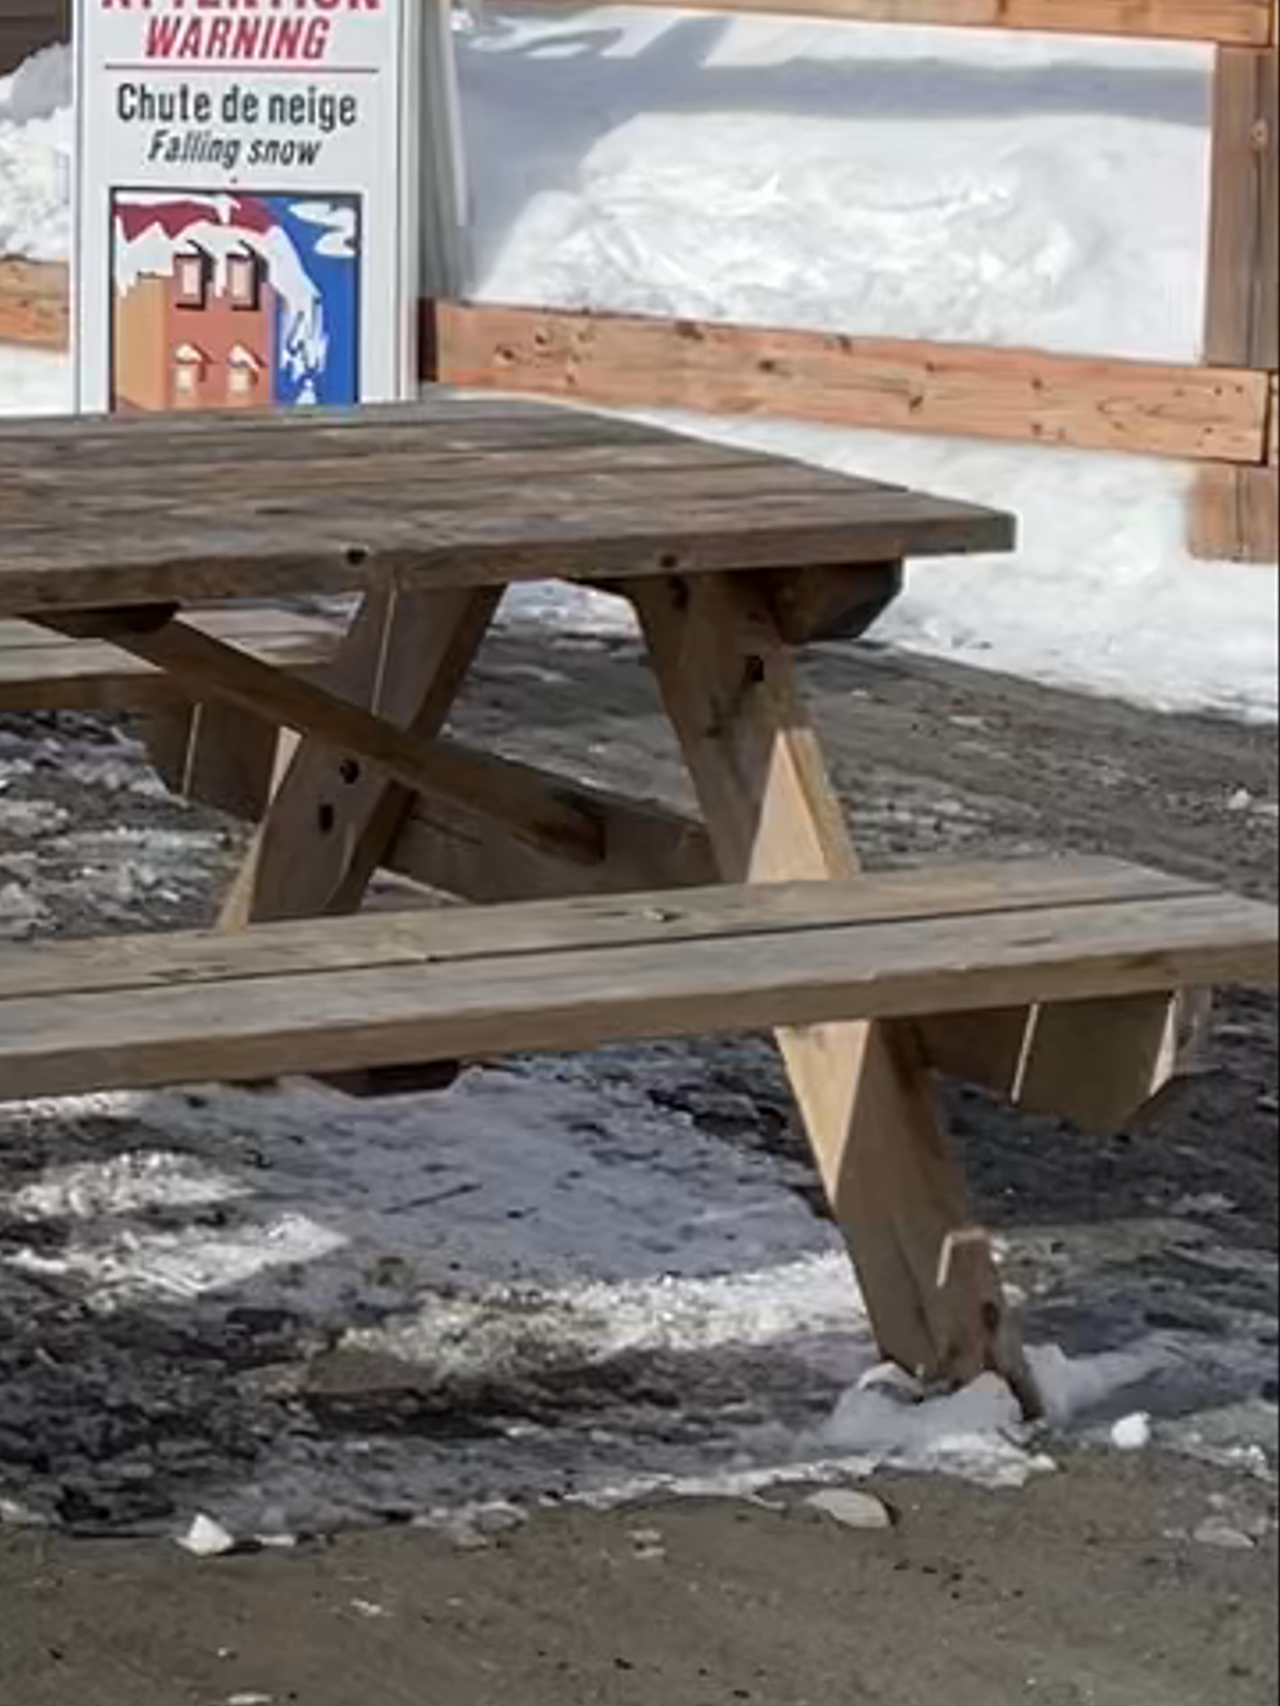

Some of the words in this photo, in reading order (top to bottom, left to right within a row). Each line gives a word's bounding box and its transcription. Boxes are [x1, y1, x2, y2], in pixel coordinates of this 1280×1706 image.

[144, 15, 330, 61] WARNING
[117, 81, 211, 124] Chute
[221, 83, 259, 125] de
[268, 85, 357, 135] neige
[146, 128, 241, 171] Falling
[246, 138, 322, 167] snow
